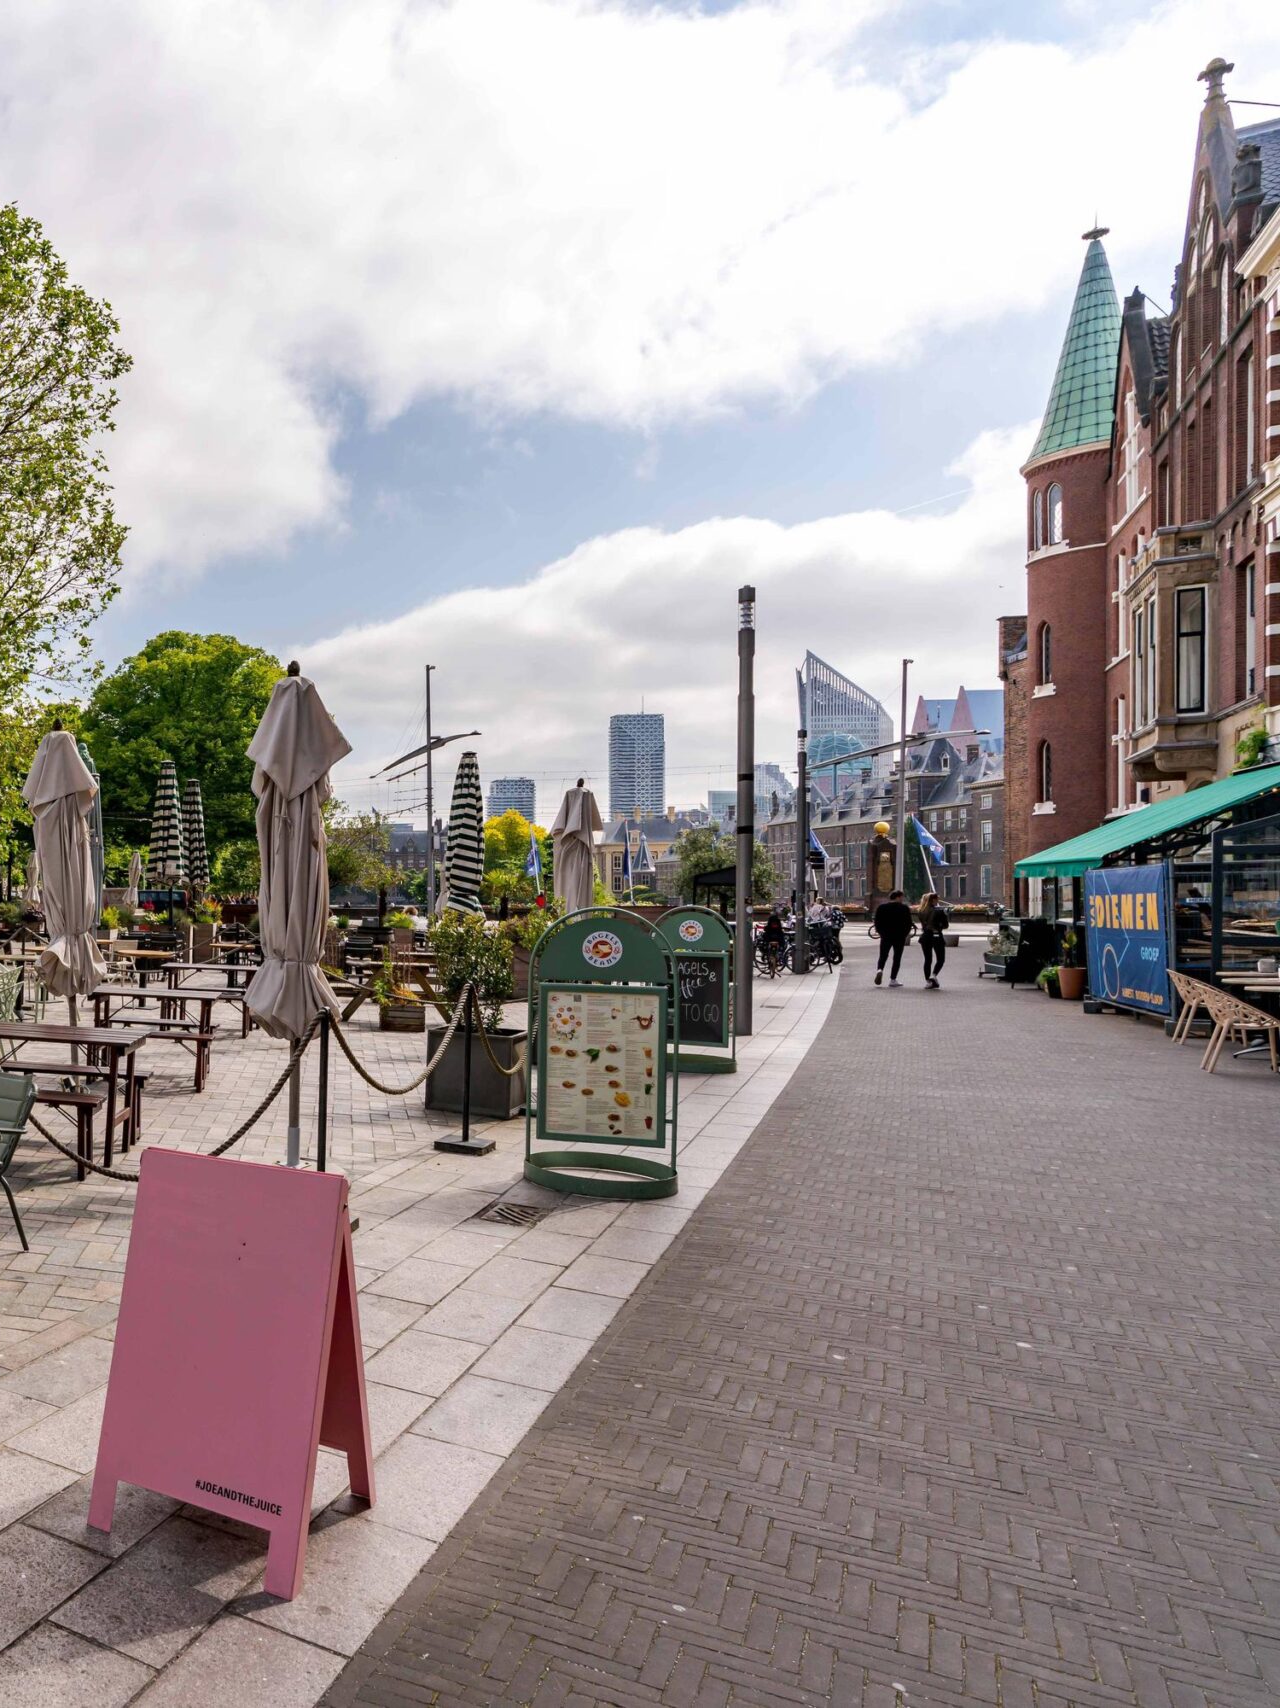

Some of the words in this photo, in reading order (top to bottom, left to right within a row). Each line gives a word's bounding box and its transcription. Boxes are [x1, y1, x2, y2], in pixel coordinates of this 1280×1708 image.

[1095, 892, 1159, 931] DIEMEN
[586, 933, 619, 946] BAGELS
[588, 955, 617, 966] BEANS
[1140, 946, 1159, 961] GROEP
[681, 1003, 701, 1022] TO
[703, 1003, 720, 1023] GO
[195, 1479, 283, 1516] #JOEANDTHEJUICE
